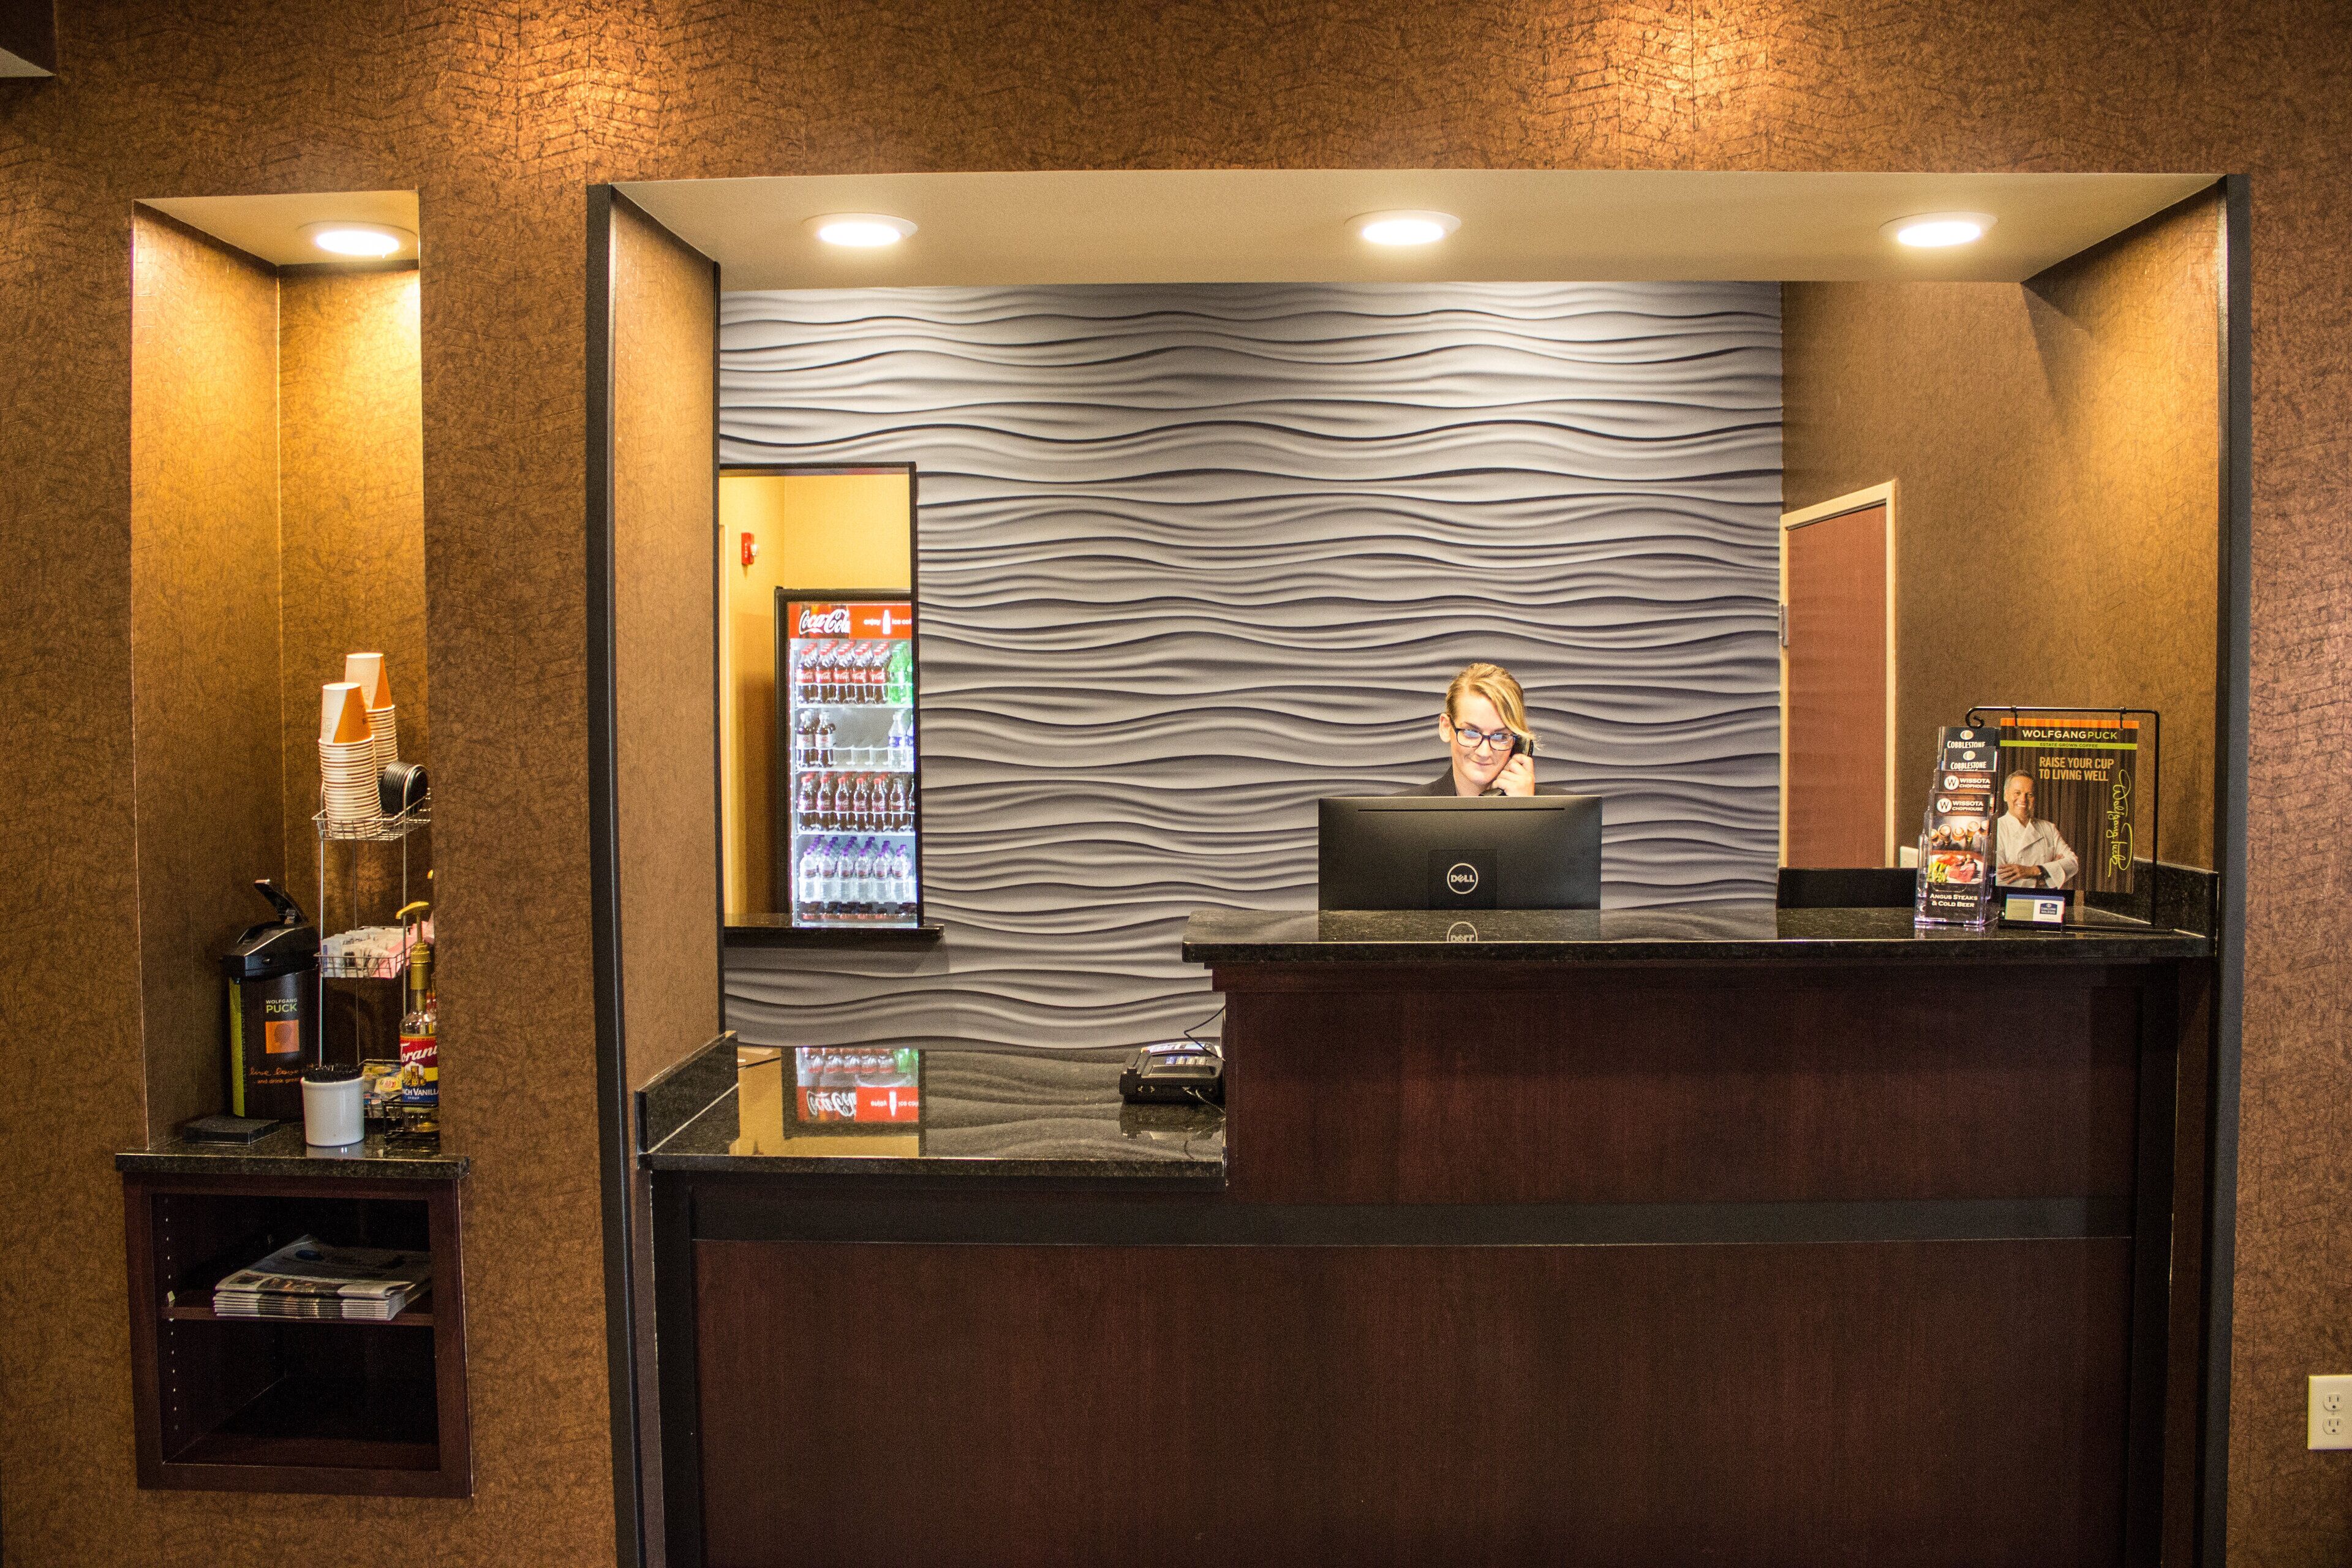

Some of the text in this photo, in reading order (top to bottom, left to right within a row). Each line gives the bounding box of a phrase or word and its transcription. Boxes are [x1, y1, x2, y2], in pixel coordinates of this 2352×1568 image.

[2039, 756, 2114, 769] RAISE YOUR CUP
[2038, 769, 2109, 781] TO LIVING WELL
[1450, 874, 1475, 883] DELL
[266, 1003, 298, 1014] PUCK
